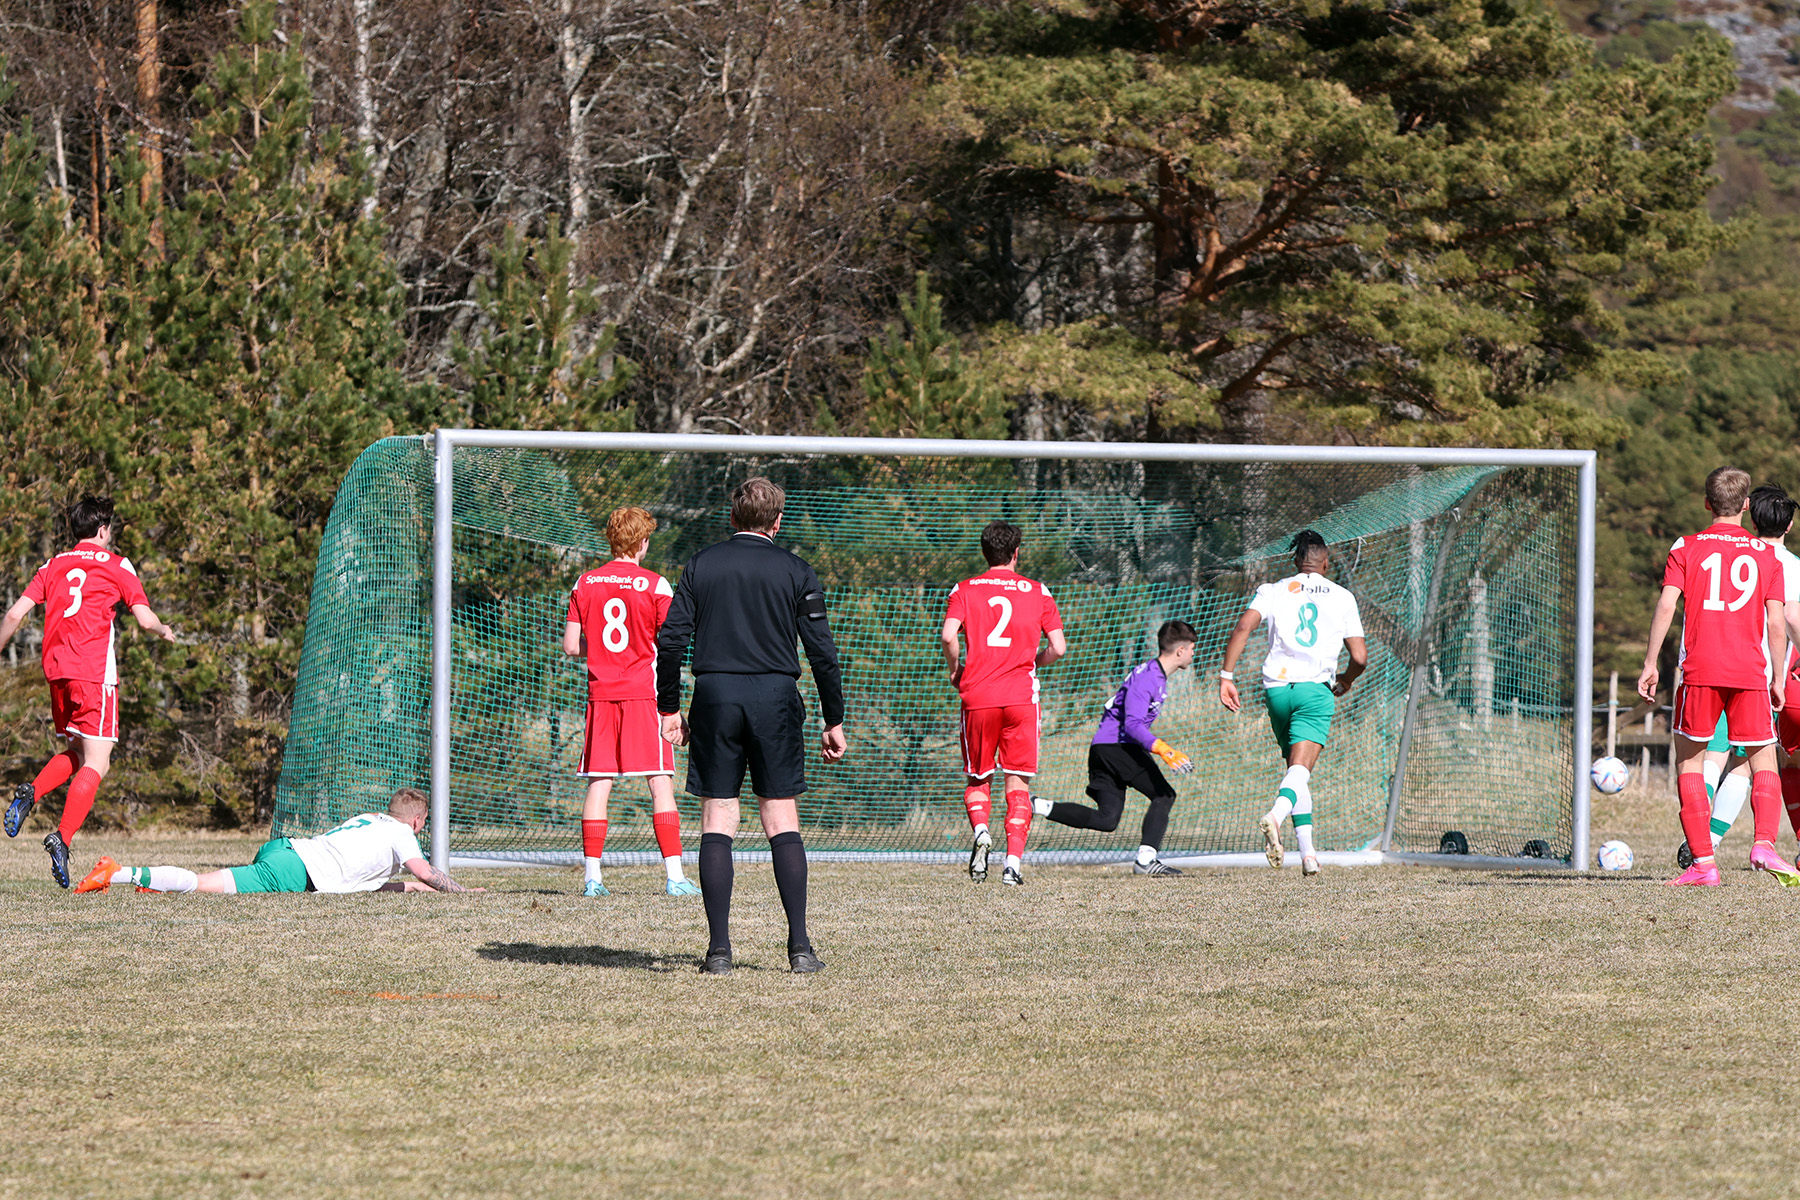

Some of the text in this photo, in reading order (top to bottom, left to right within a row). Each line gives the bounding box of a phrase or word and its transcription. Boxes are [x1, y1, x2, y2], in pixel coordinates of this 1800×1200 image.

[1696, 533, 1749, 543] SpareBank
[63, 567, 87, 618] 3
[585, 575, 633, 584] SpareBank
[1700, 552, 1759, 612] 19
[602, 597, 629, 653] 8
[987, 595, 1013, 648] 2
[1295, 602, 1319, 648] 8
